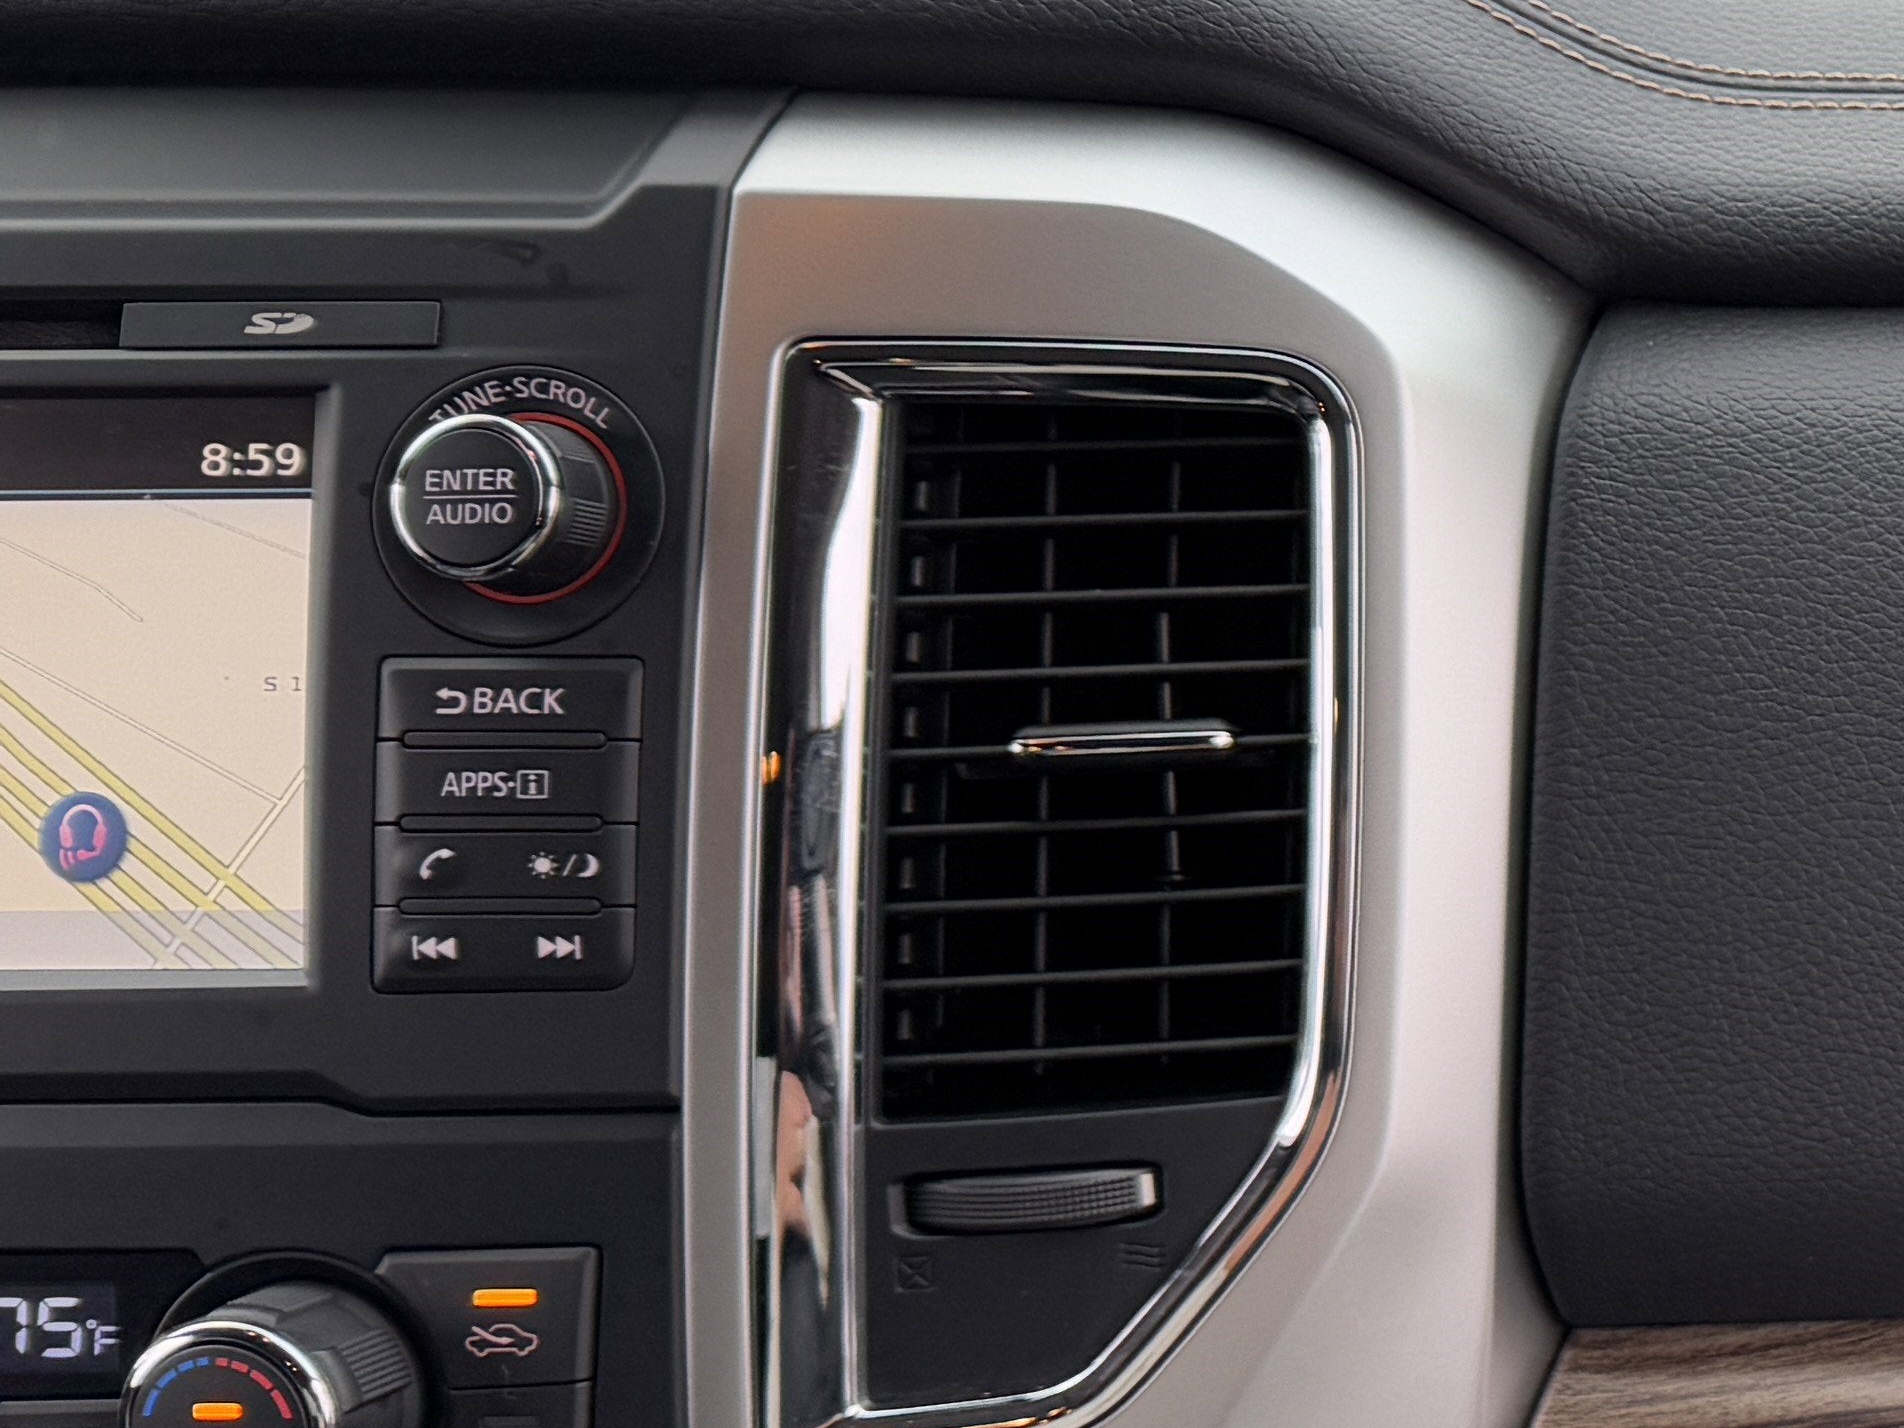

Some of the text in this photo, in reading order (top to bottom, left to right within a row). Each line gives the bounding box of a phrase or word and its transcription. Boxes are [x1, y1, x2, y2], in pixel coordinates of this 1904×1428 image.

[201, 442, 306, 476] 8:59
[425, 468, 515, 492] ENTER
[426, 502, 514, 525] AUDIO
[264, 676, 277, 692] S
[473, 687, 566, 715] BACK
